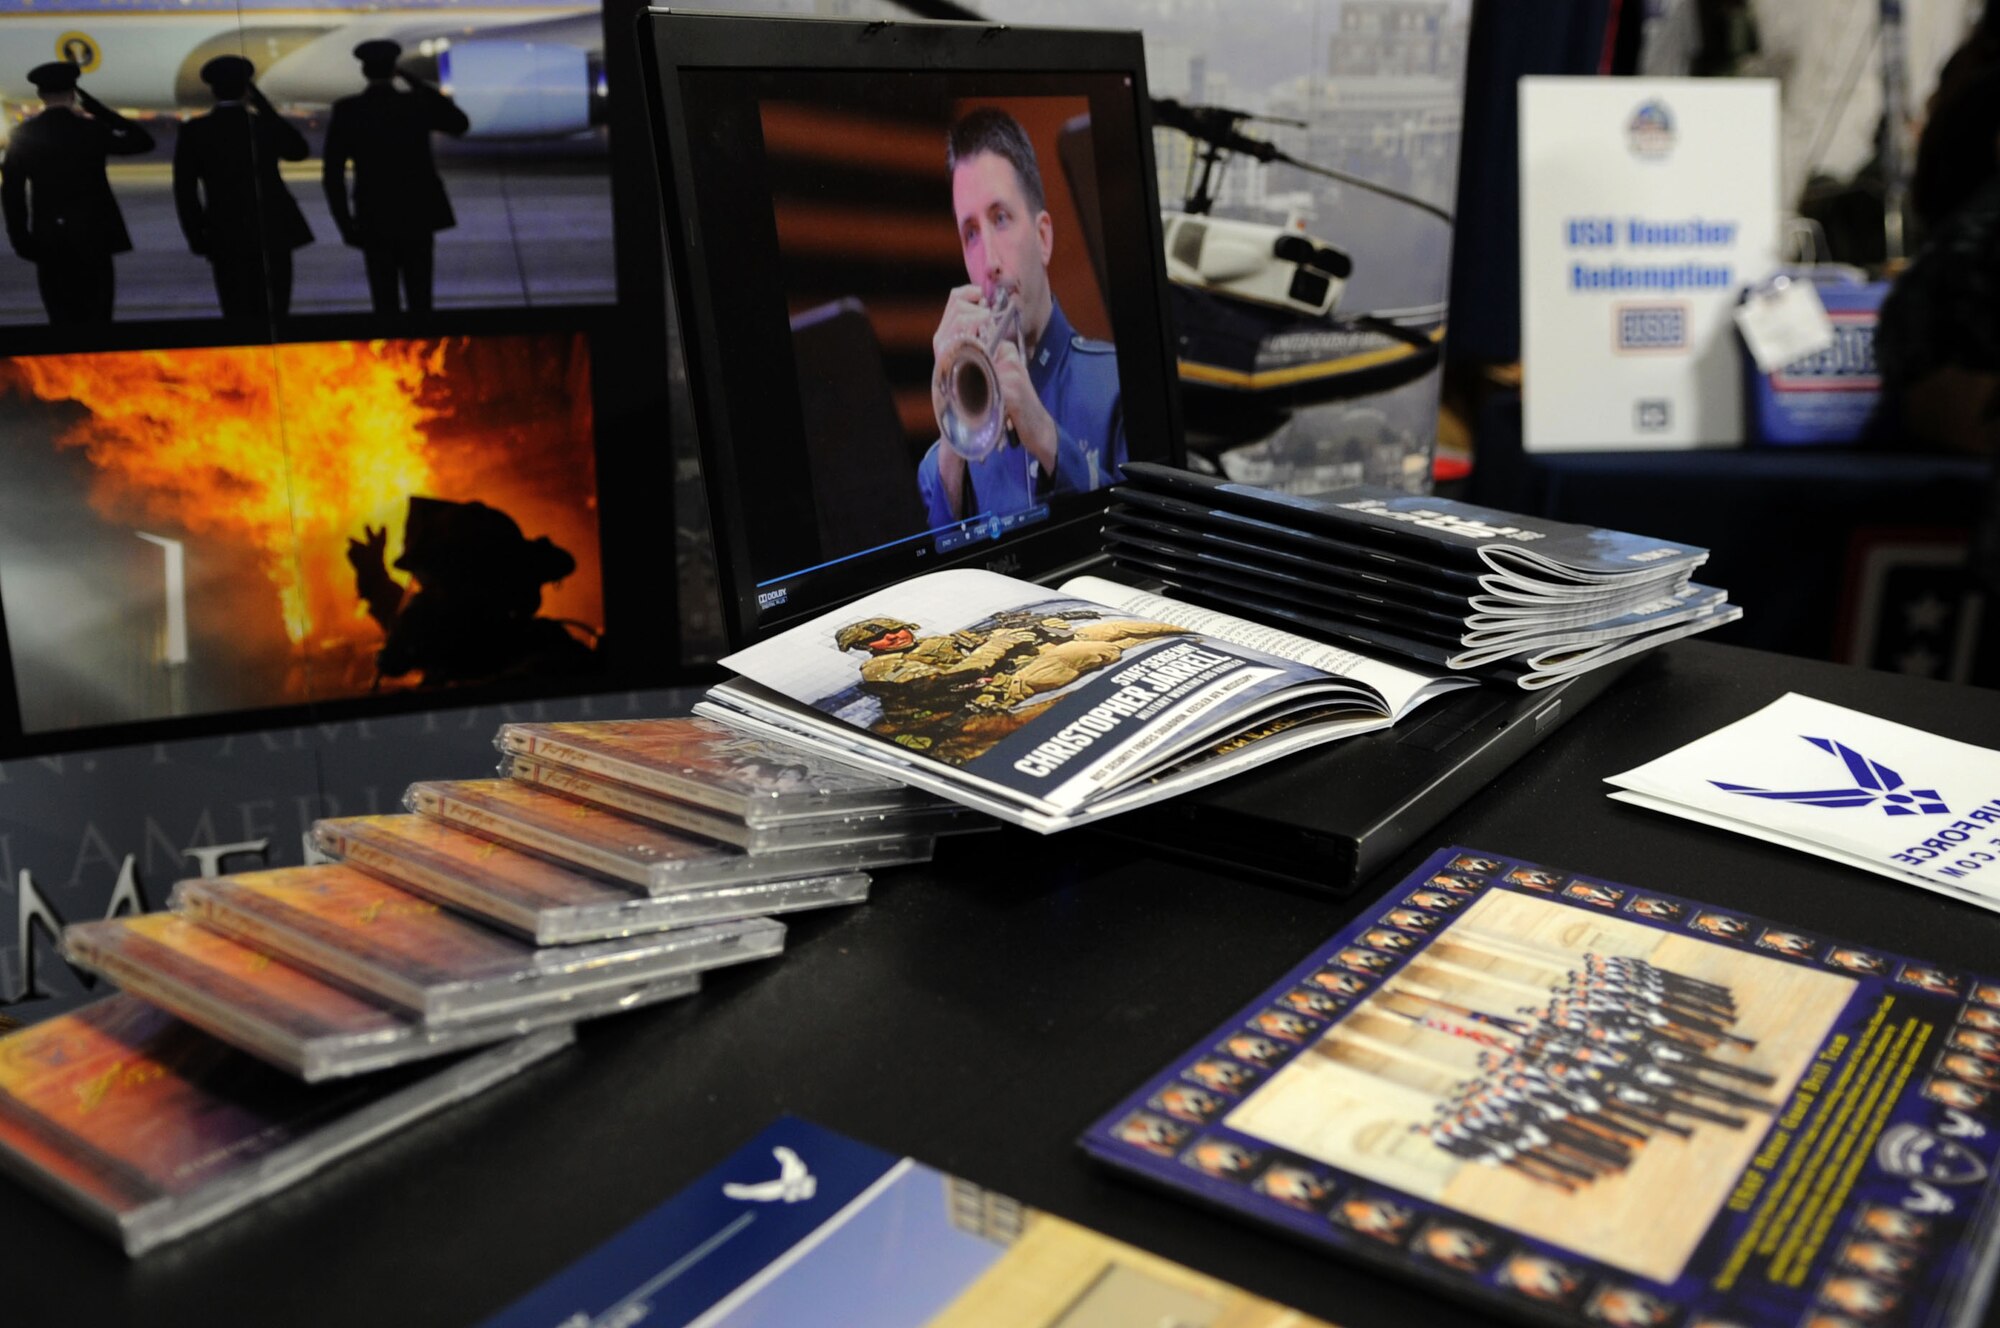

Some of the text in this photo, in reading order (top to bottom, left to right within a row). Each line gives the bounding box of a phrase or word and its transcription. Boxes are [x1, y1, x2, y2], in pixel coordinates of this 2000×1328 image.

[767, 588, 787, 601] DOLBY
[1110, 643, 1200, 686] STAFF SERGEANT
[1014, 684, 1160, 778] CHRISTOPHER
[1140, 650, 1232, 693] JARRELL
[1135, 696, 1173, 721] MILITARY
[1166, 678, 1205, 699] WORKING
[1198, 671, 1218, 682] DOG
[1104, 749, 1137, 771] SECURITY
[1132, 734, 1159, 752] FORCES
[1727, 1034, 1850, 1212] USAF Honor Guard Drill Team
